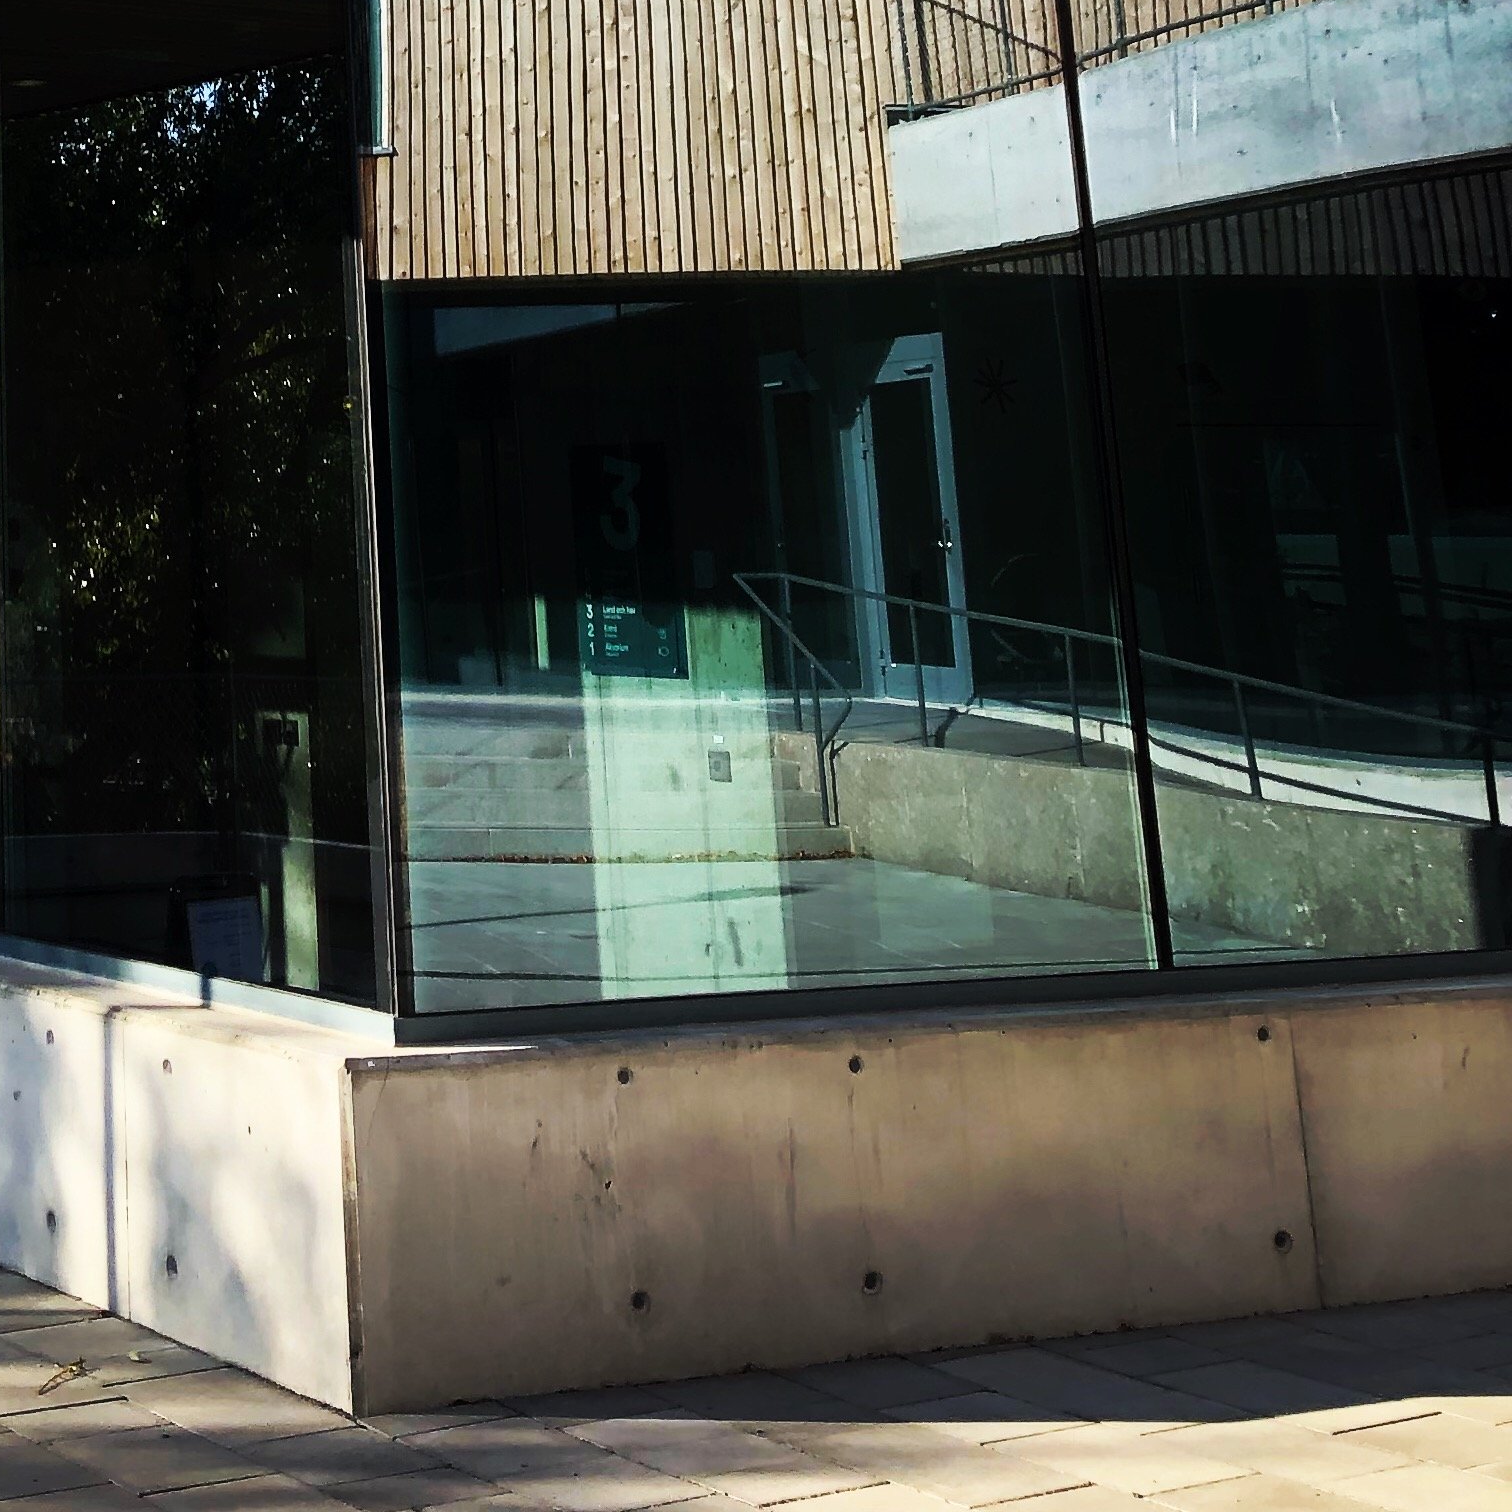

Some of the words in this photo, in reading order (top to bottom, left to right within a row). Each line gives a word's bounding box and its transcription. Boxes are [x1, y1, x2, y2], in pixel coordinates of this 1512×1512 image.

[600, 455, 641, 551] 3
[586, 604, 594, 619] 3
[587, 622, 595, 638] 2
[589, 641, 595, 656] 1
